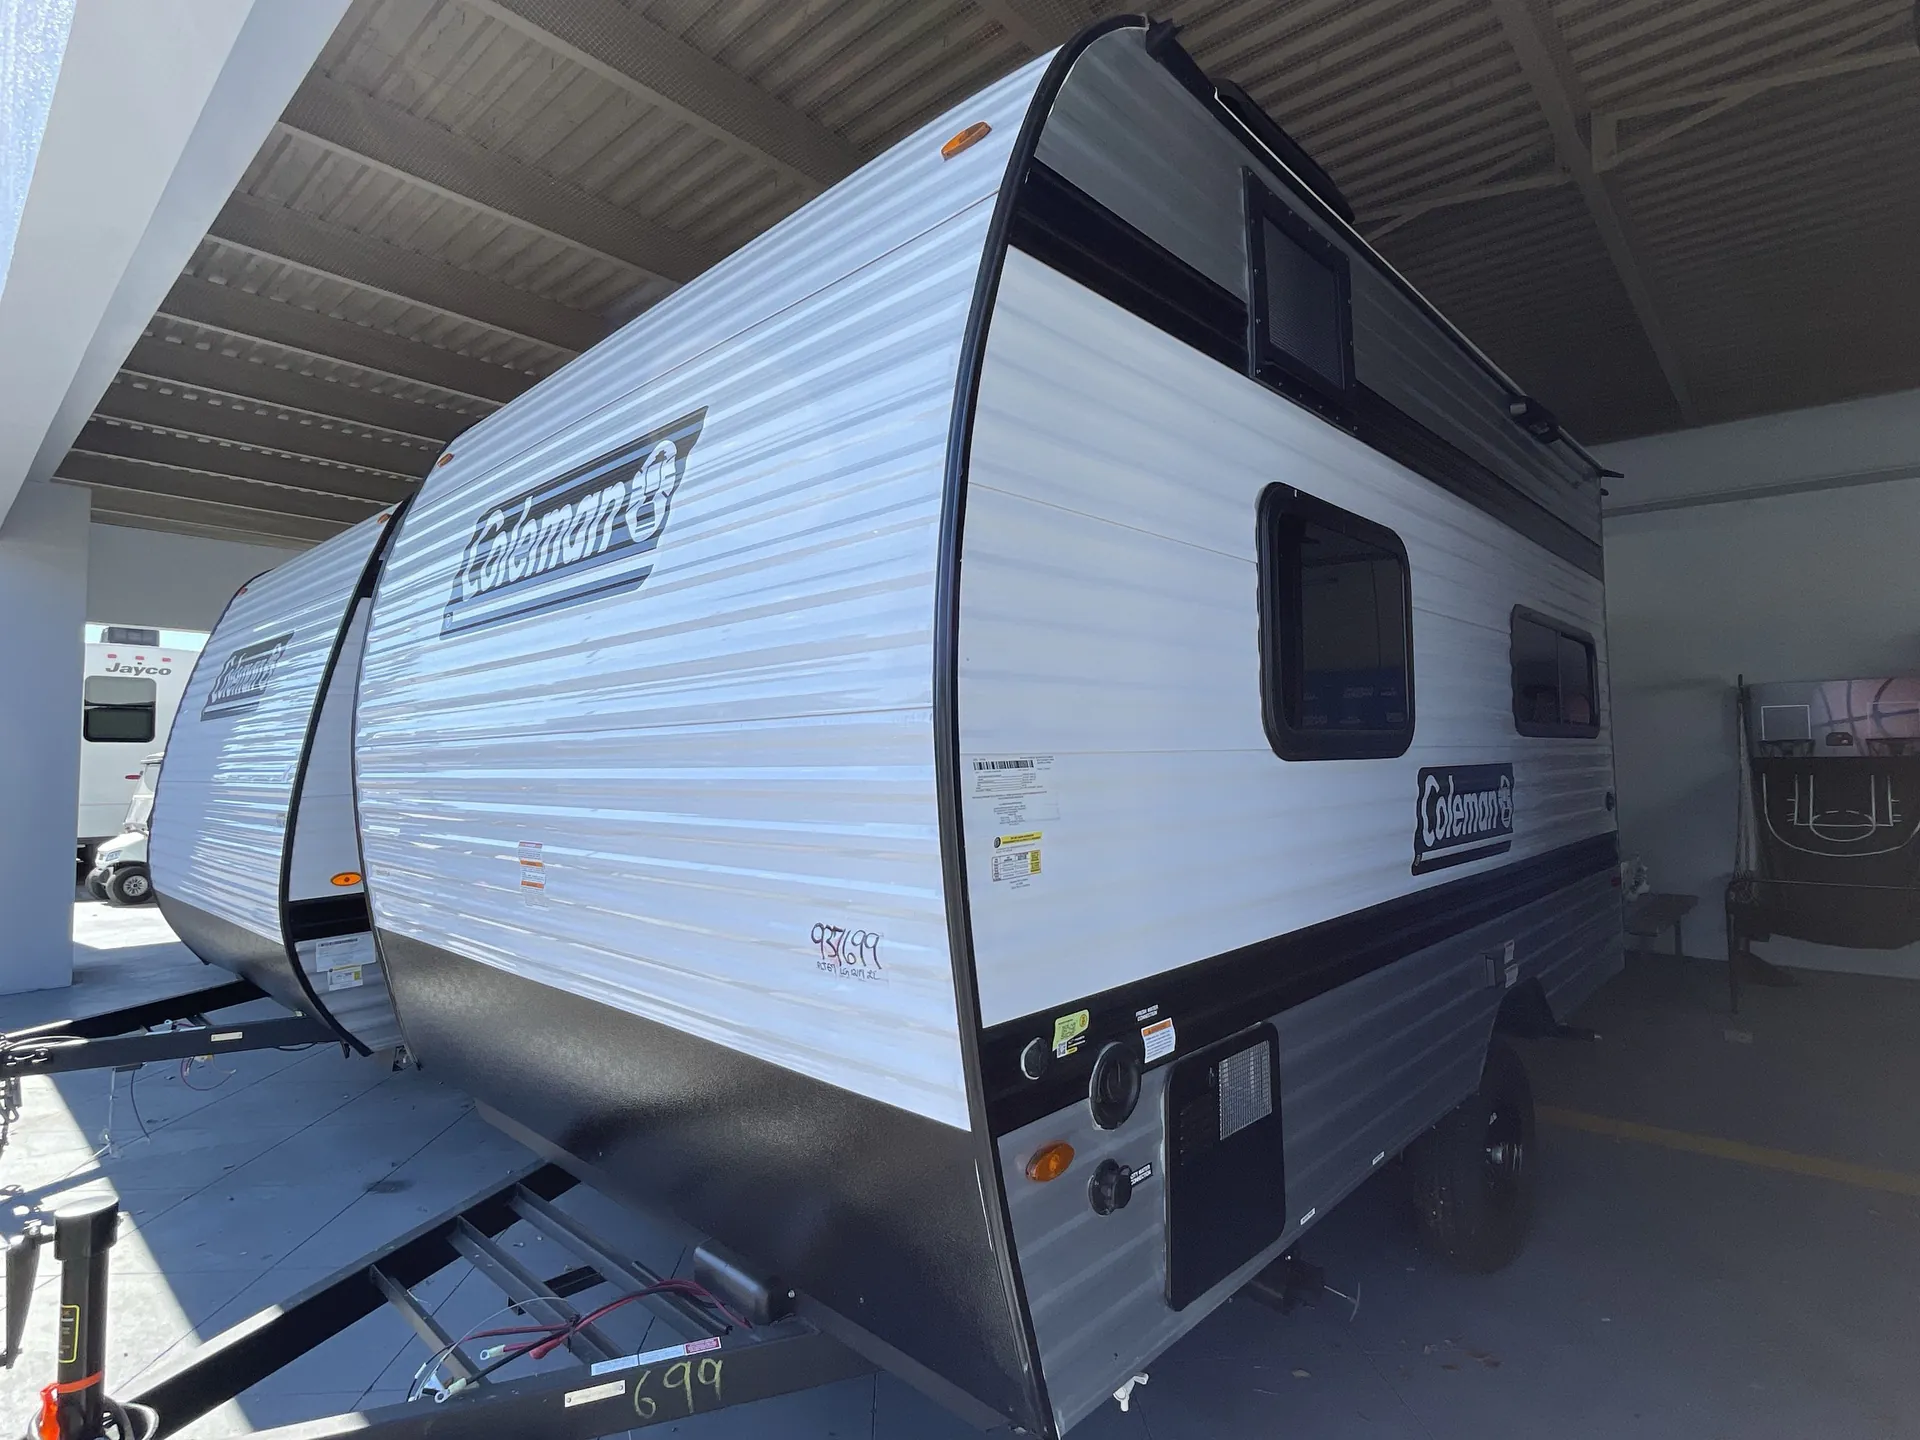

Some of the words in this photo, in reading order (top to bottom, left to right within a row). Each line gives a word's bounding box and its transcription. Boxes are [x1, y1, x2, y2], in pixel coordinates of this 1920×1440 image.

[461, 481, 626, 601] Coleman
[105, 662, 171, 676] Jayco
[1421, 774, 1498, 847] Coleman
[634, 1358, 723, 1419] 699
